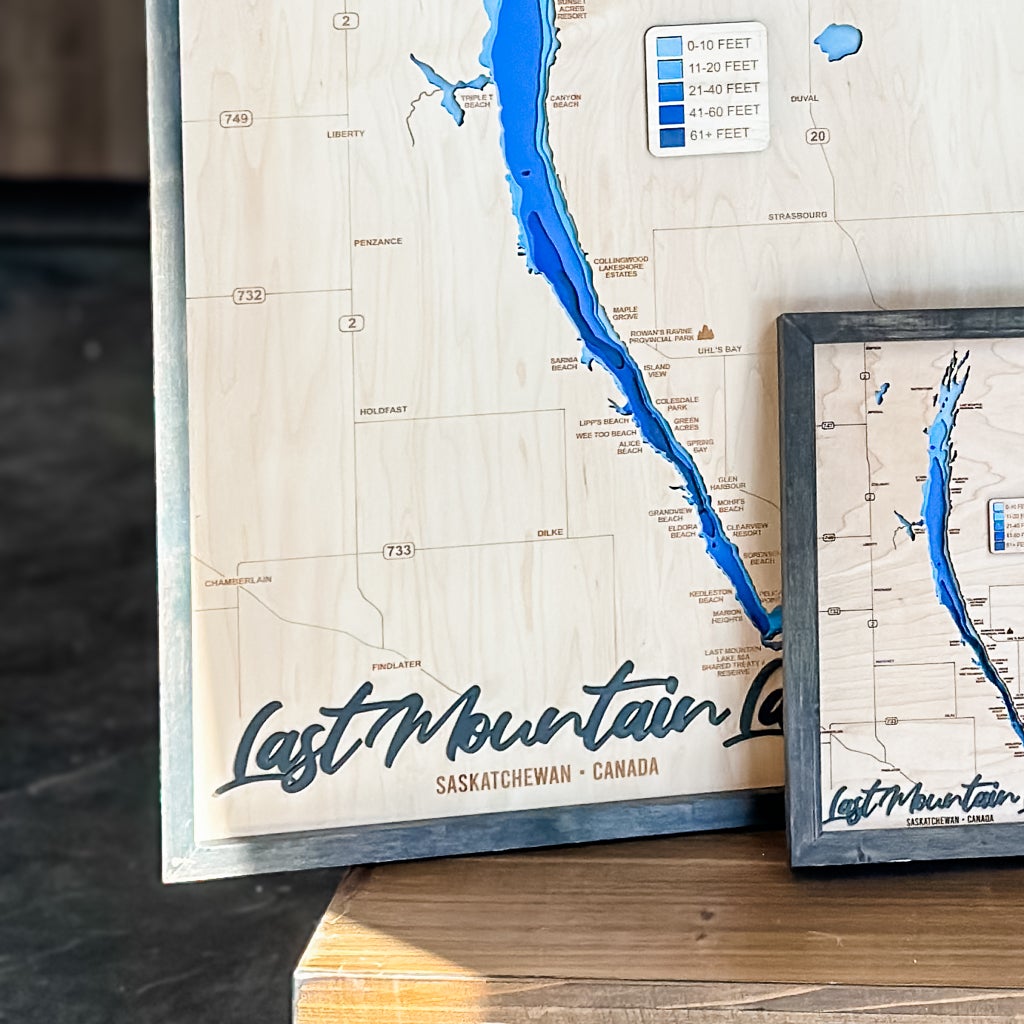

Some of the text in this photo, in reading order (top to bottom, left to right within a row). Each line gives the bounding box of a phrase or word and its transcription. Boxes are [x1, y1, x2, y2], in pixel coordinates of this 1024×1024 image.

[342, 16, 350, 26] 2
[687, 38, 752, 51] 0-10 FEET
[688, 60, 759, 73] 11-20 FEET
[688, 82, 760, 95] 21-40 FEET
[791, 94, 818, 102] DUVAL
[689, 104, 760, 118] 41-60 FEET
[224, 113, 248, 124] 749
[327, 130, 365, 139] LIBERTY
[690, 126, 749, 139] 61+ FEET
[810, 130, 826, 141] 20
[768, 211, 828, 220] STRASBOURG
[354, 238, 402, 246] PENZANCE
[238, 290, 262, 301] 732
[348, 318, 356, 328] 2
[360, 405, 407, 415] HOLDFAST
[537, 528, 564, 537] DILKE
[387, 544, 412, 557] 733
[204, 575, 272, 588] CHAMBERLAIN
[371, 660, 422, 672] FINDLATER
[212, 658, 783, 798] Last Mountain La
[436, 757, 659, 795] SASKATCHEWAN CANADA
[821, 779, 884, 826] Last
[878, 774, 1021, 814] Mountain
[906, 814, 994, 826] SASKATCHEWAN CANADA
